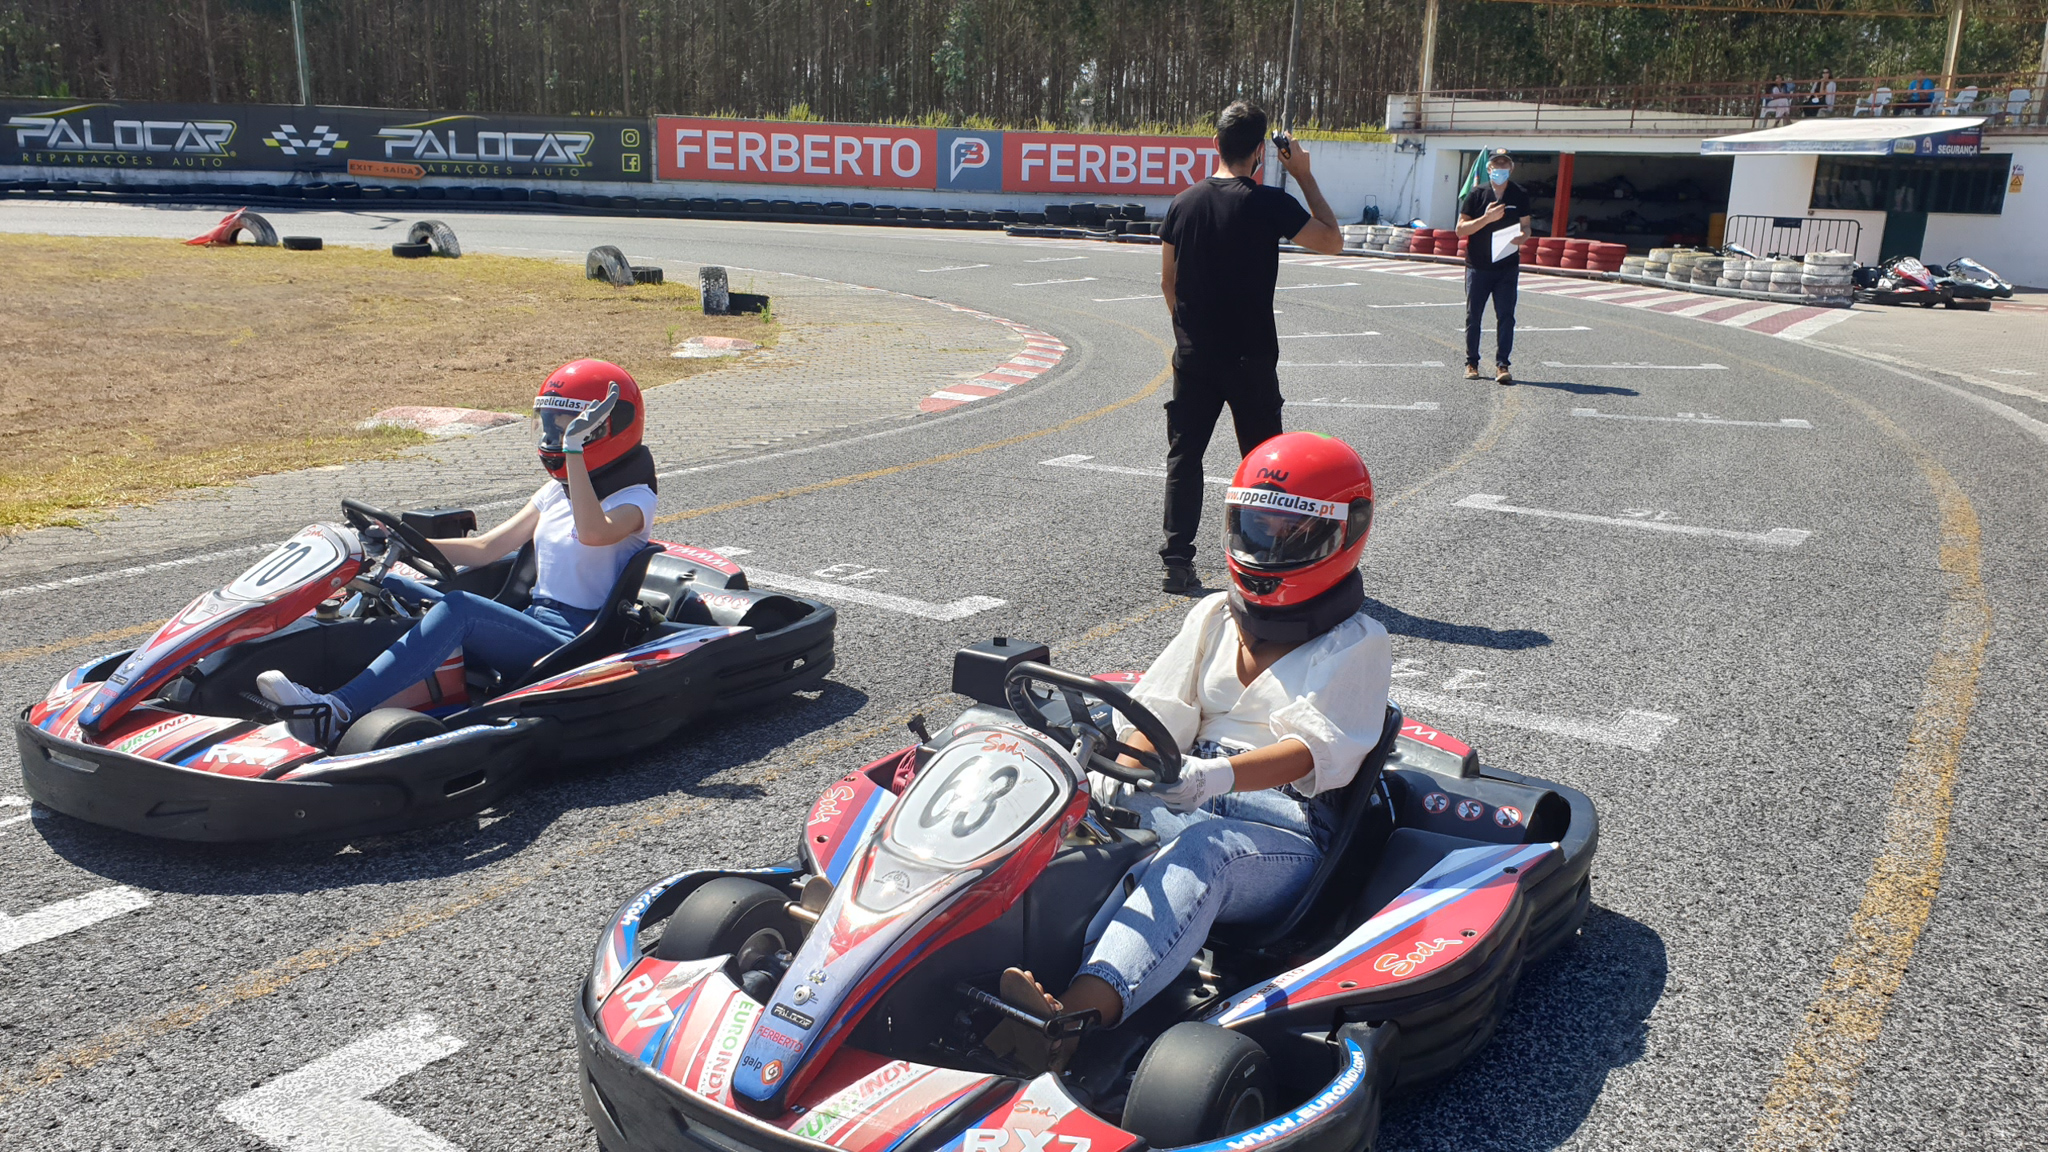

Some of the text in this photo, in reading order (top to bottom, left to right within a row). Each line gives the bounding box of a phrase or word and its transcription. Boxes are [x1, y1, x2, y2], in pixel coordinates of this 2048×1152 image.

[8, 117, 236, 155] PALOCAR
[378, 128, 594, 166] PALOCAR
[676, 128, 922, 178] FERBERTO
[1938, 144, 1978, 156] SEGURANÇA
[22, 152, 222, 167] REPARAÇÕES AUTO
[350, 163, 373, 173] EXIT
[383, 164, 414, 175] SAÍDA
[427, 164, 580, 177] ARAÇÕES AUTO
[1021, 143, 1220, 185] FERBERT
[121, 715, 194, 752] UROIND
[981, 734, 1025, 762] Sodi
[806, 785, 855, 827] Sodi
[1374, 937, 1464, 977] Sodi
[615, 972, 676, 1029] RX7
[705, 1000, 755, 1102] EUROINDY
[756, 1025, 804, 1053] FERBERTO
[742, 1055, 762, 1071] galp
[796, 1061, 911, 1137] EURINDY
[1013, 1099, 1059, 1125] Sodi
